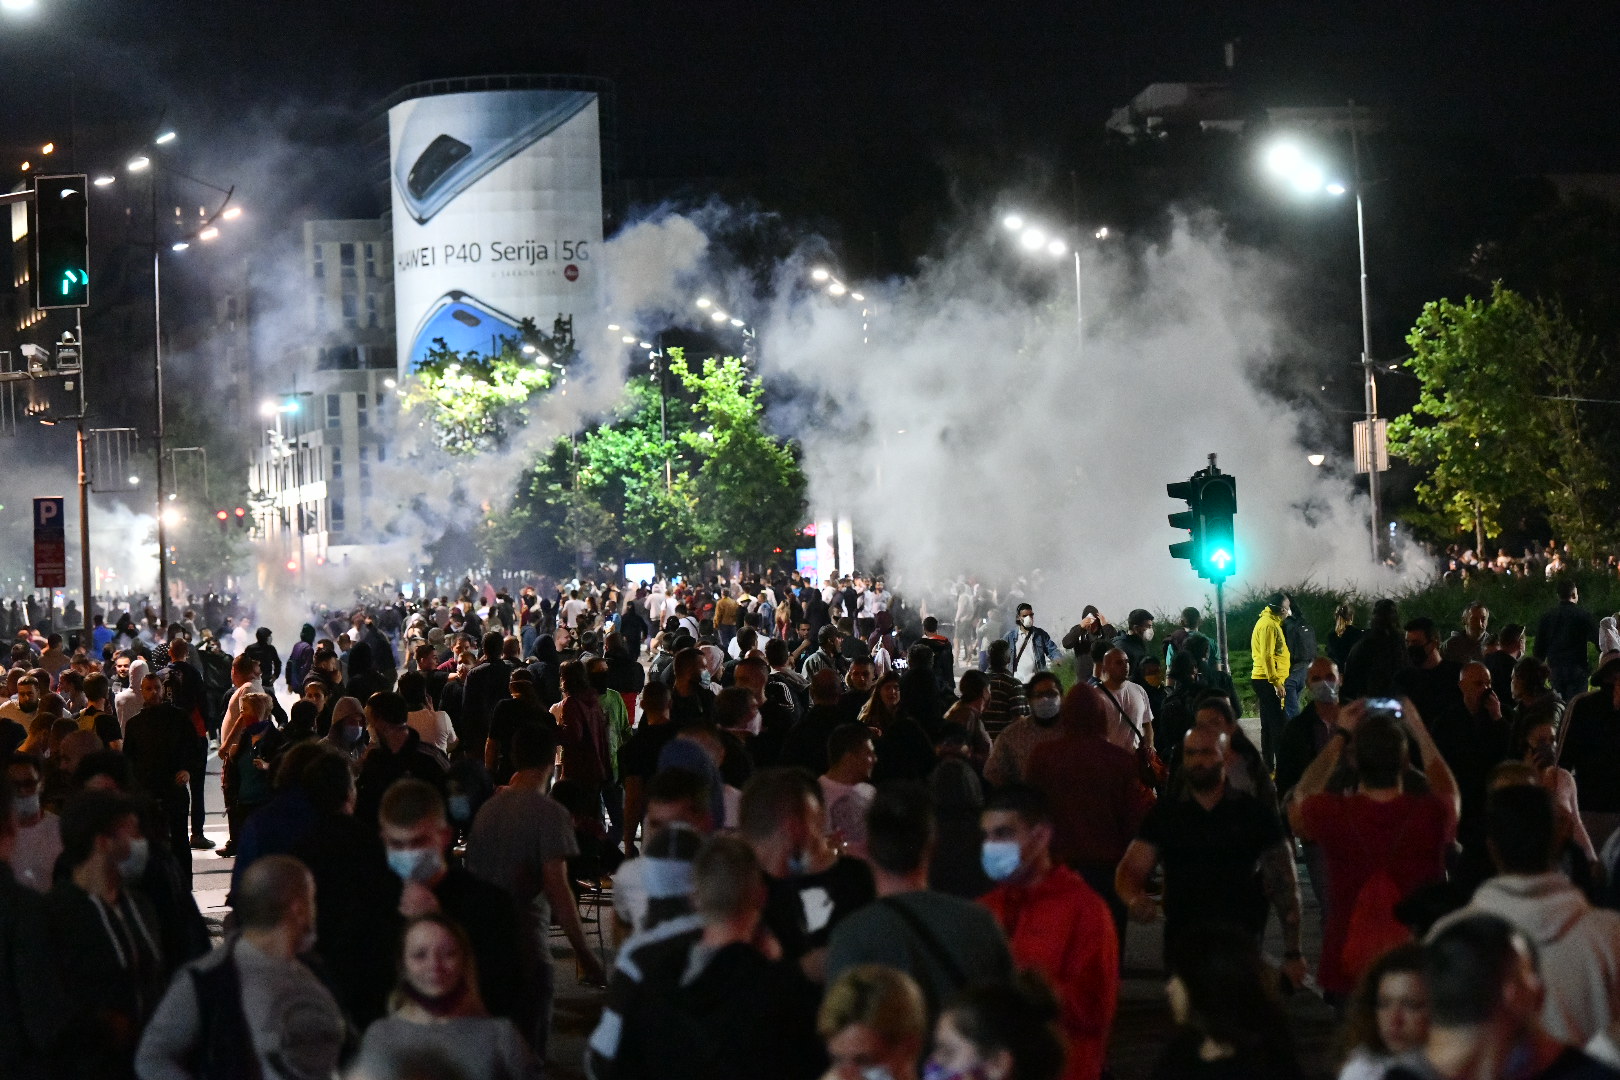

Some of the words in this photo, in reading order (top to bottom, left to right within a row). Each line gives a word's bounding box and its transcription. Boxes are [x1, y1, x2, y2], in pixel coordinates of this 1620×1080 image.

[398, 247, 436, 272] WEI
[444, 243, 482, 265] P40
[490, 241, 549, 266] Serija
[562, 240, 590, 261] 5G
[39, 501, 58, 525] P
